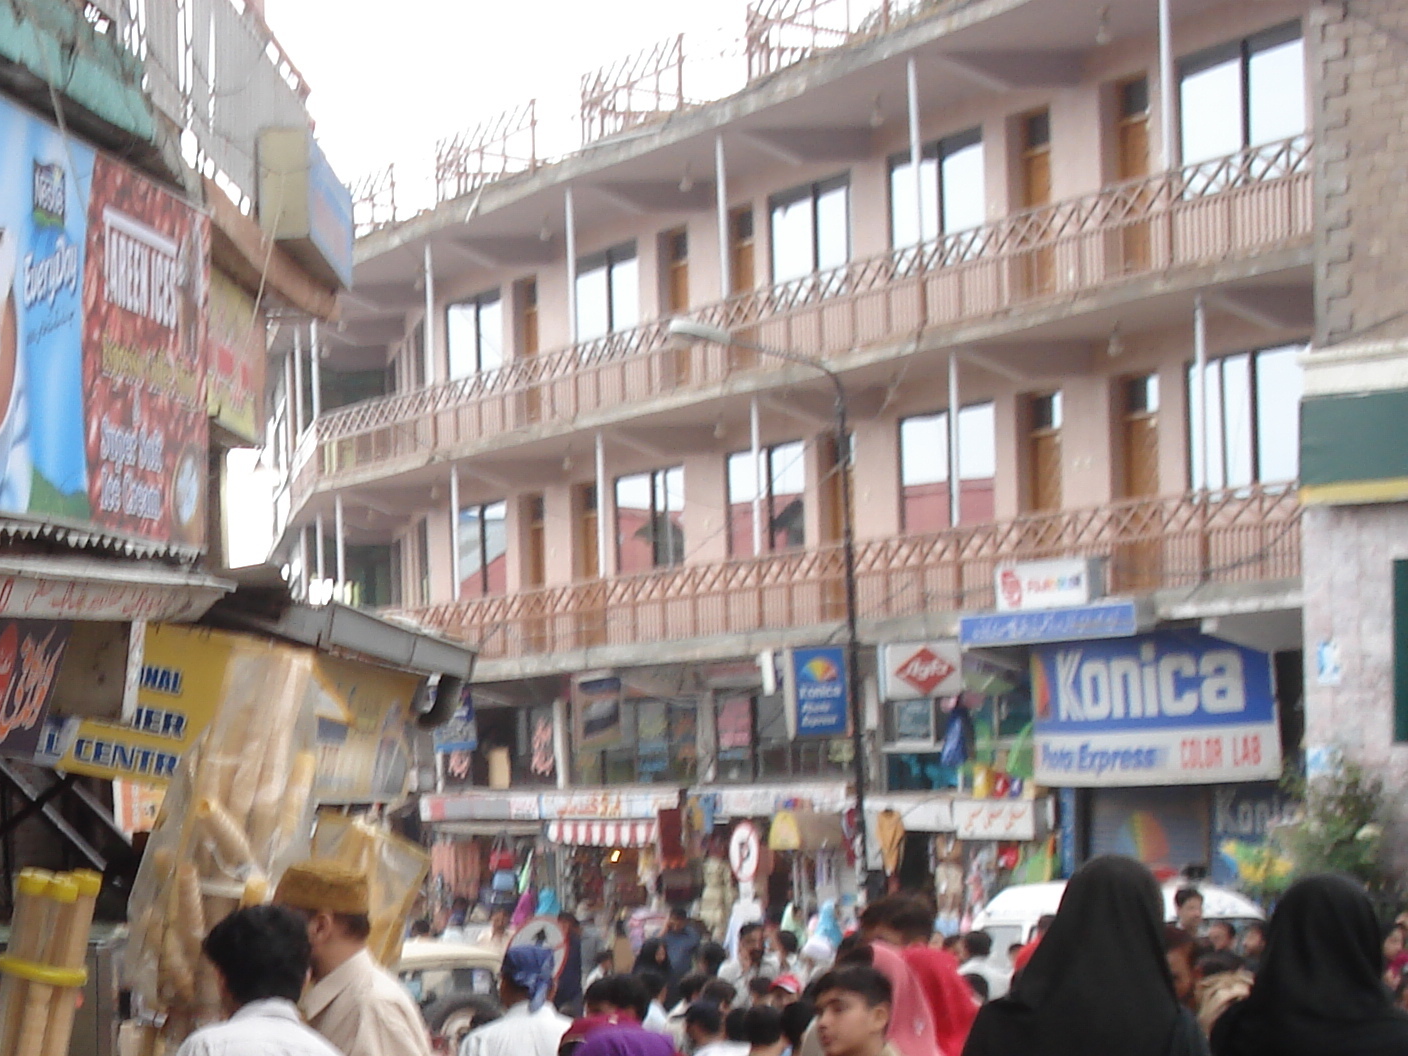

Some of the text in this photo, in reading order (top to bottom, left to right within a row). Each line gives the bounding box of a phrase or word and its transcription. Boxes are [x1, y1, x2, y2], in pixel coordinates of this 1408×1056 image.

[798, 682, 842, 700] Konica
[1055, 641, 1246, 722] Konica
[1180, 735, 1223, 771] COLOR
[1232, 732, 1263, 769] LAB
